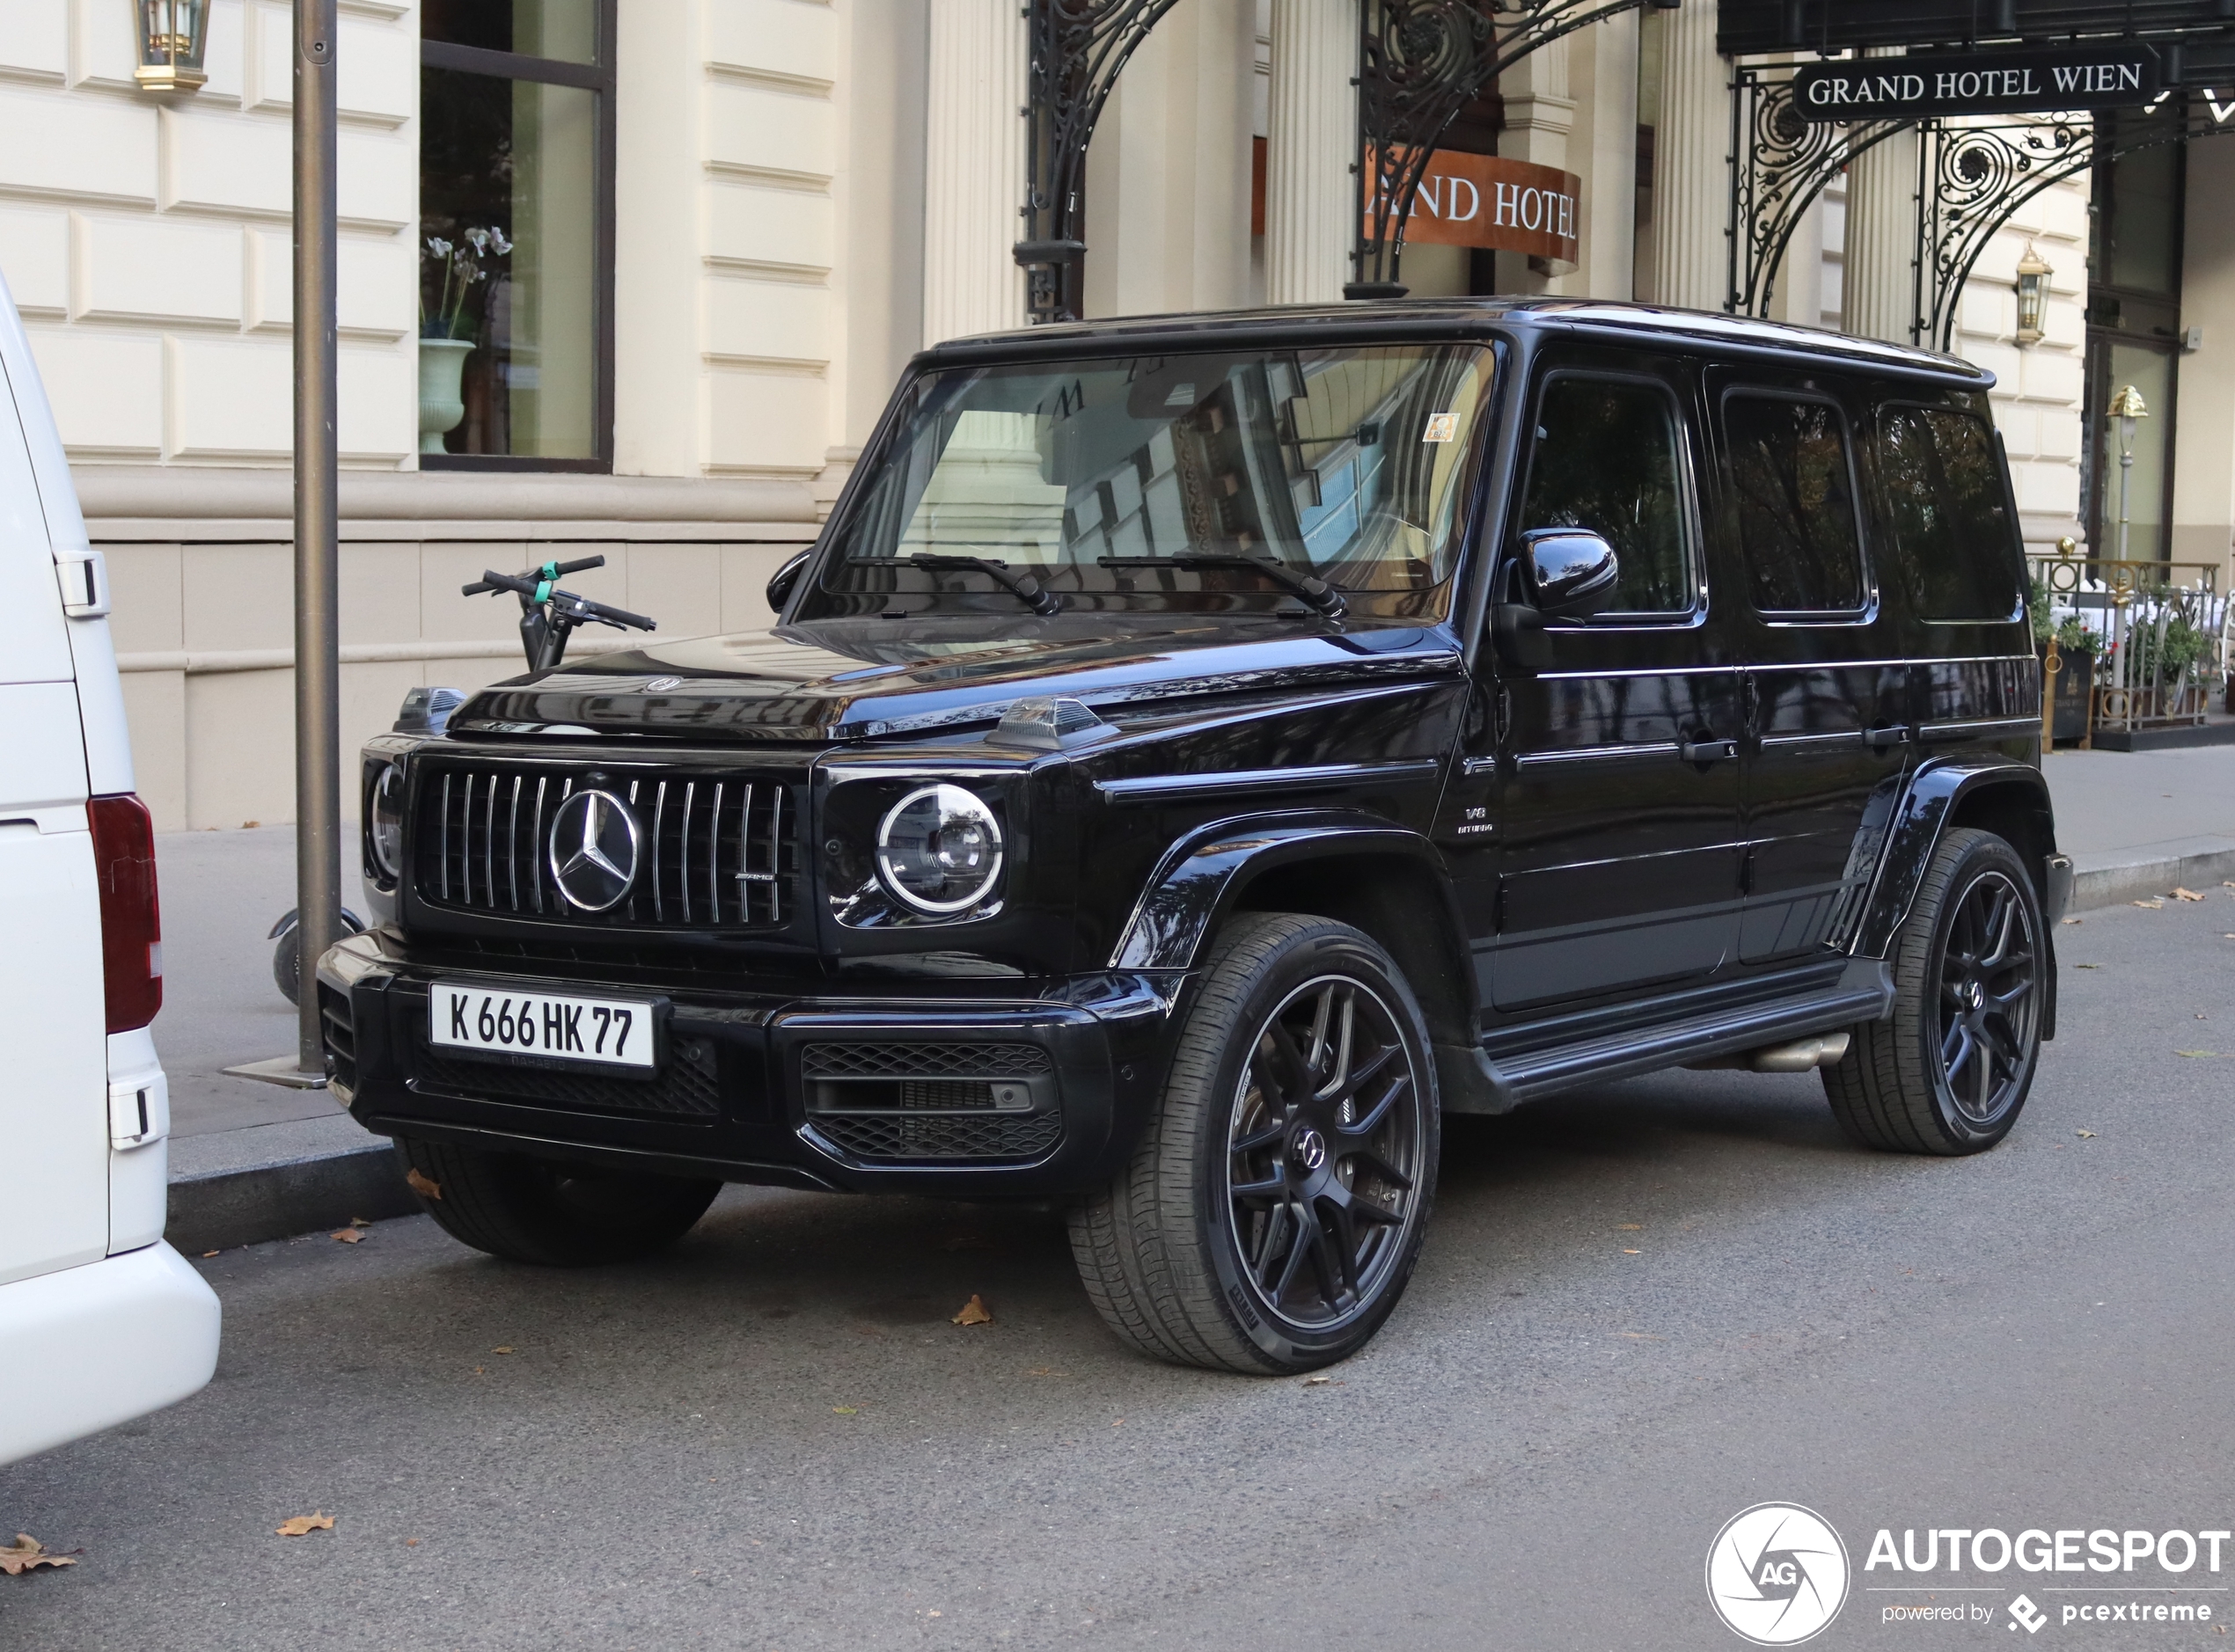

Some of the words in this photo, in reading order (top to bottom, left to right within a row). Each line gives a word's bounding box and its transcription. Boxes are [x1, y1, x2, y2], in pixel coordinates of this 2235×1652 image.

[1808, 74, 1924, 105] GRAND
[1934, 69, 2041, 99] HOTEL
[2051, 63, 2143, 92] WIEN
[1365, 173, 1480, 222] AND
[1493, 181, 1576, 240] HOTEL
[1465, 807, 1487, 820] V8
[1457, 823, 1493, 834] BITURBO
